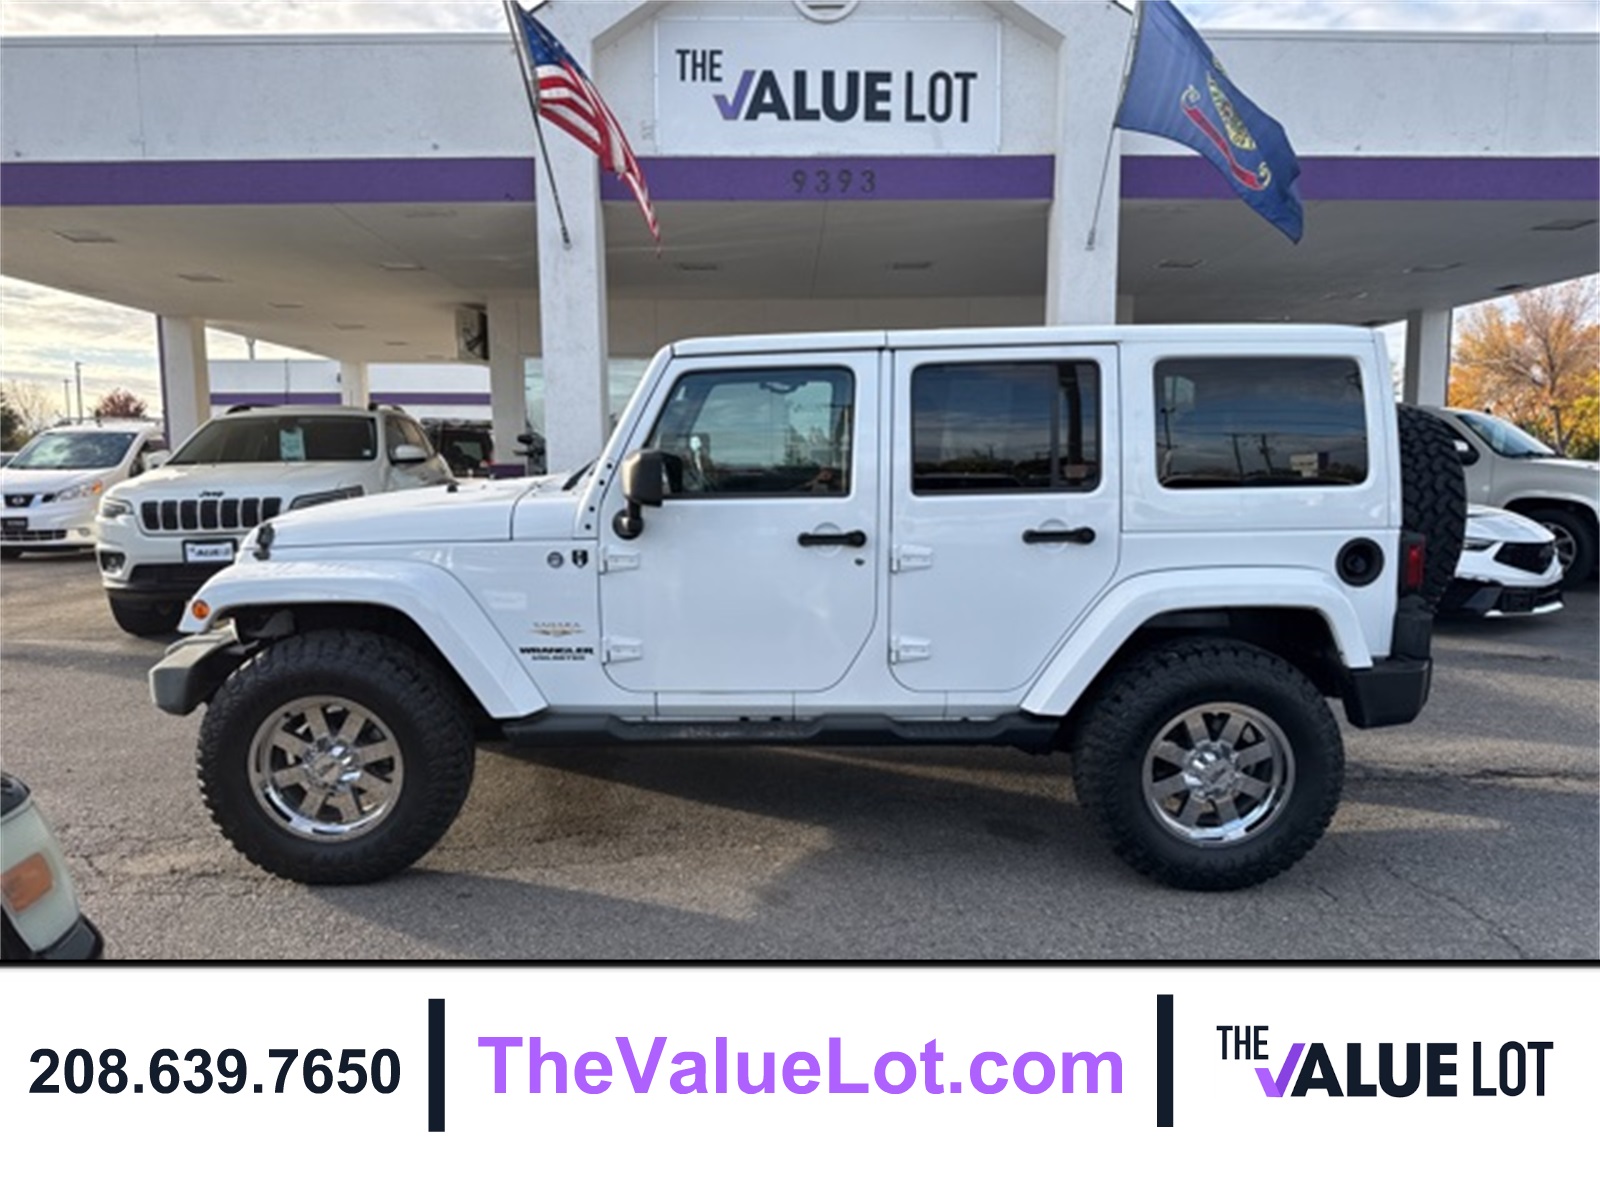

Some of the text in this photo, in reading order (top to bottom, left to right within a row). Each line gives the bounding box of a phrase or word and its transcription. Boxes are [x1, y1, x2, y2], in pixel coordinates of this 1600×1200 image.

[676, 49, 977, 123] THE VALUE LOT
[792, 169, 876, 193] 9393
